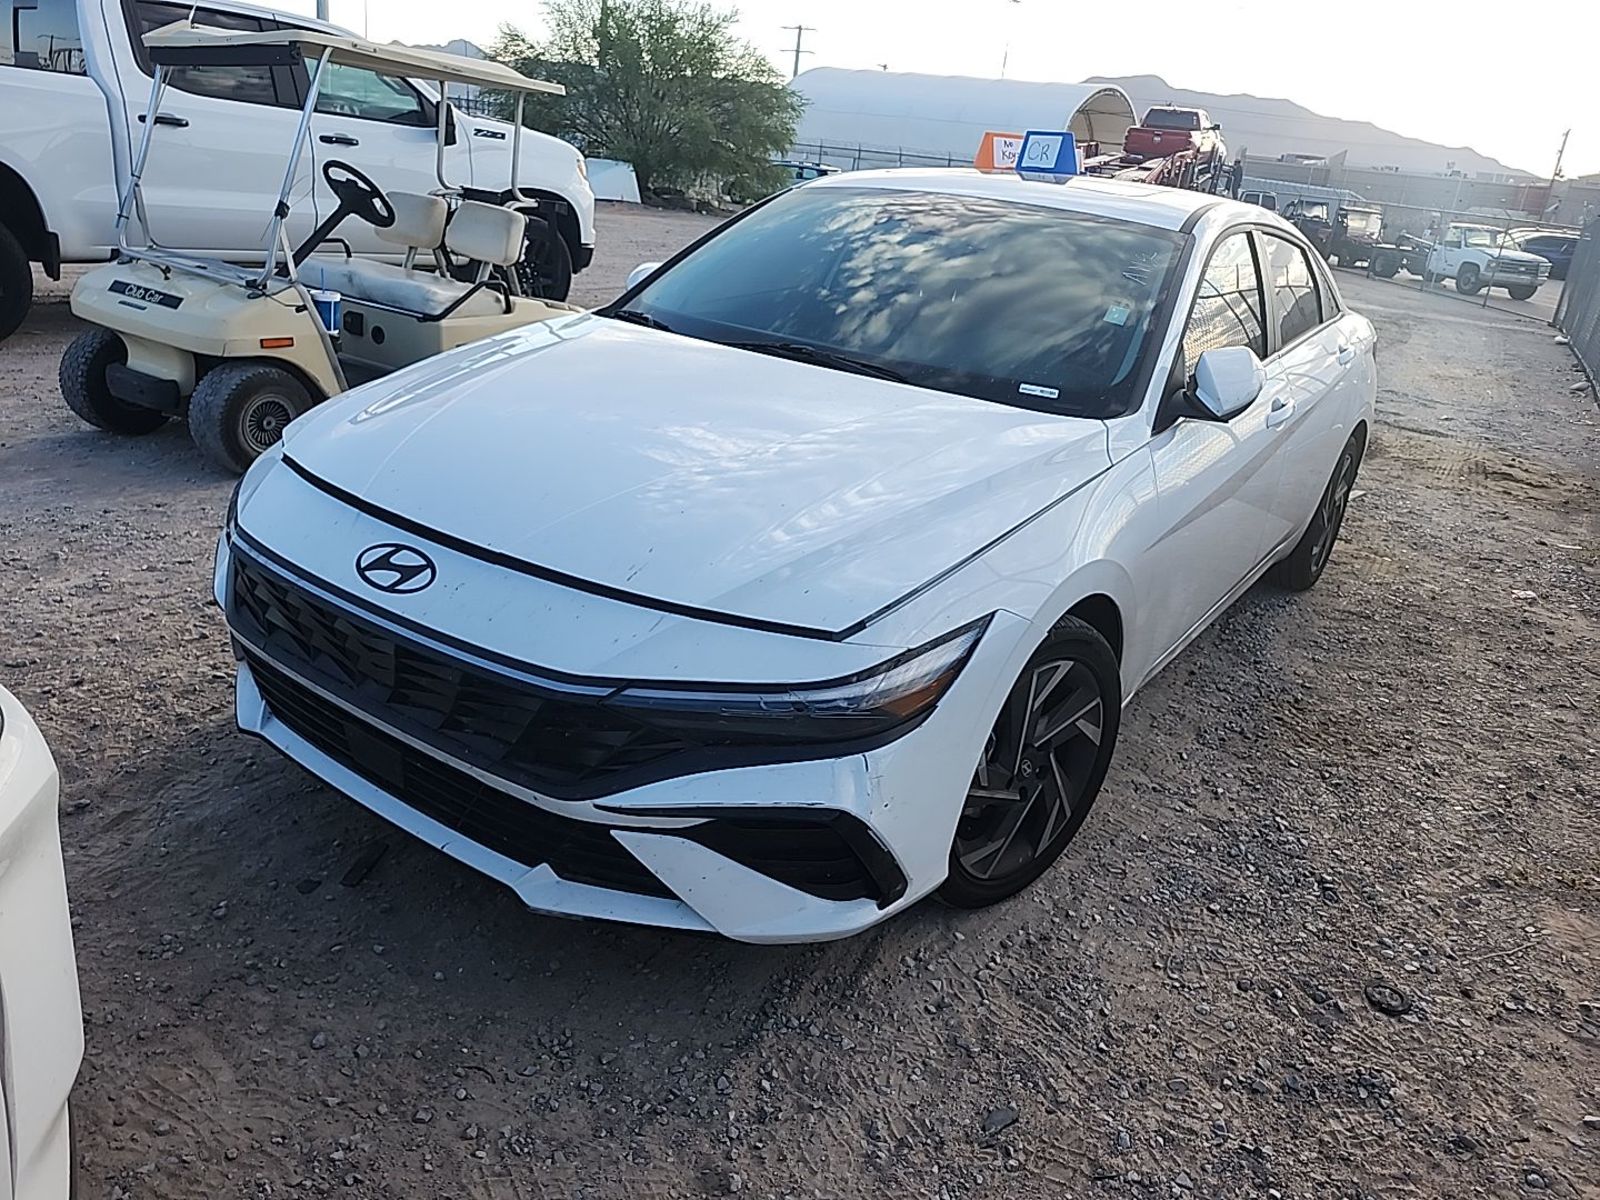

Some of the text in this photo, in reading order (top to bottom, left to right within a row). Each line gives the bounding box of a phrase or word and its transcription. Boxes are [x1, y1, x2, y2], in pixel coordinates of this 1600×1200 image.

[1027, 140, 1051, 161] CR
[125, 283, 164, 303] Club Car
